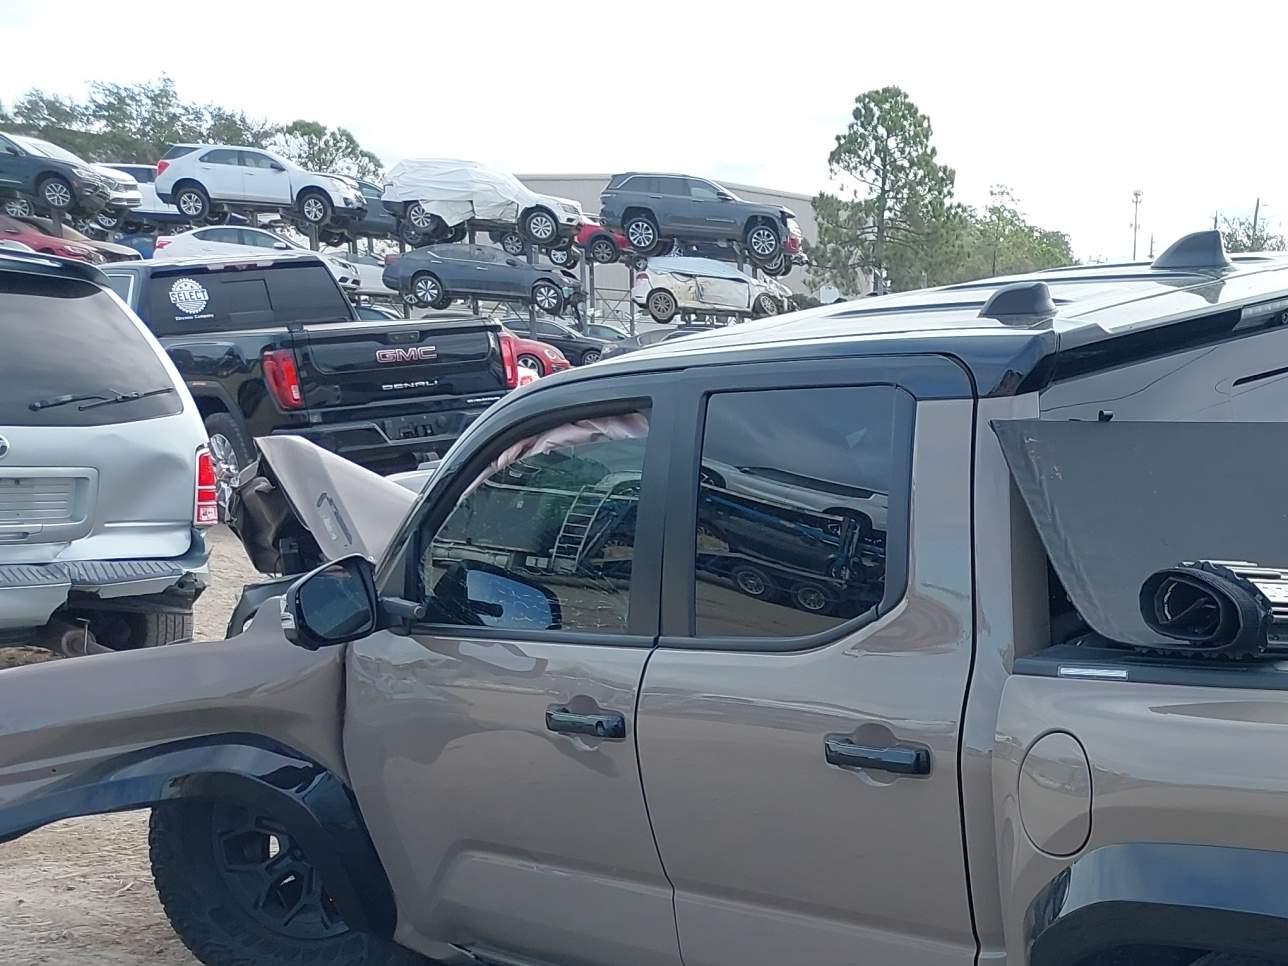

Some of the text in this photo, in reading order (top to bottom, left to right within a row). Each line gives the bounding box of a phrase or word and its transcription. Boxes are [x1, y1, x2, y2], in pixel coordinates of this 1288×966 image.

[170, 289, 207, 303] SELECT
[376, 345, 438, 363] GMC
[382, 379, 438, 391] DENALI
